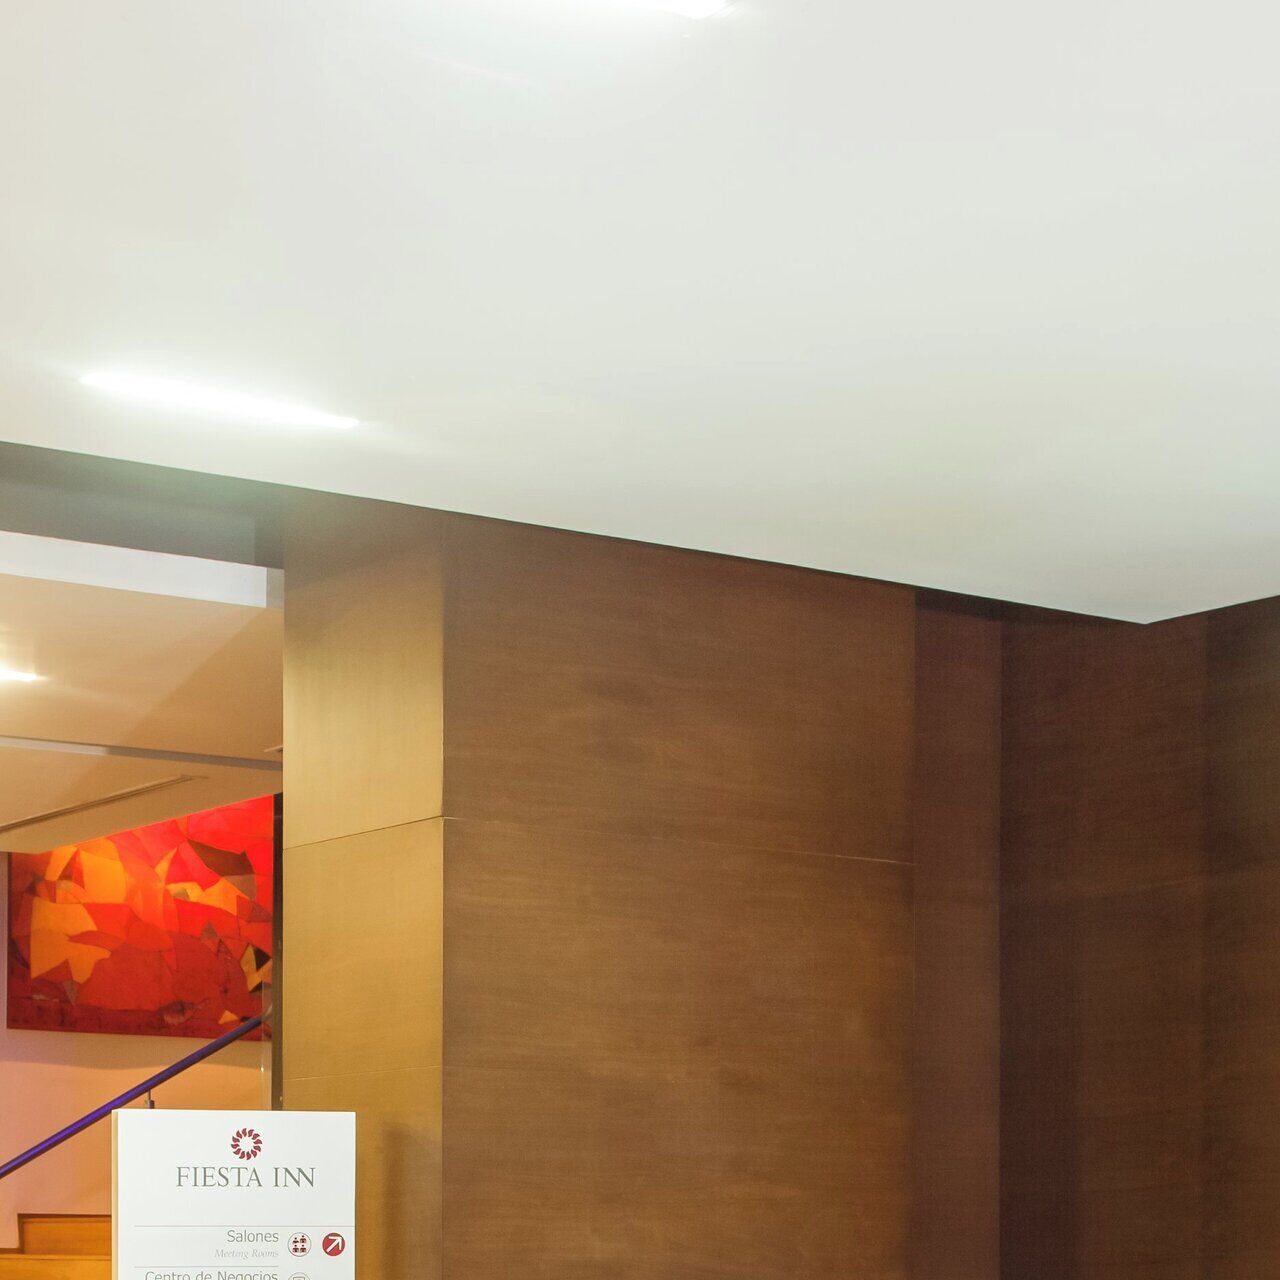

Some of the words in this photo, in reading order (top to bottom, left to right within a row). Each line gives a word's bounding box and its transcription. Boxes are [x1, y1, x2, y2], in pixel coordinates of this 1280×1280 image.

[176, 1166, 263, 1188] FIESTA
[273, 1166, 316, 1188] INN
[226, 1229, 280, 1244] Salones
[213, 1247, 249, 1261] Meeting
[251, 1248, 279, 1259] Rooms
